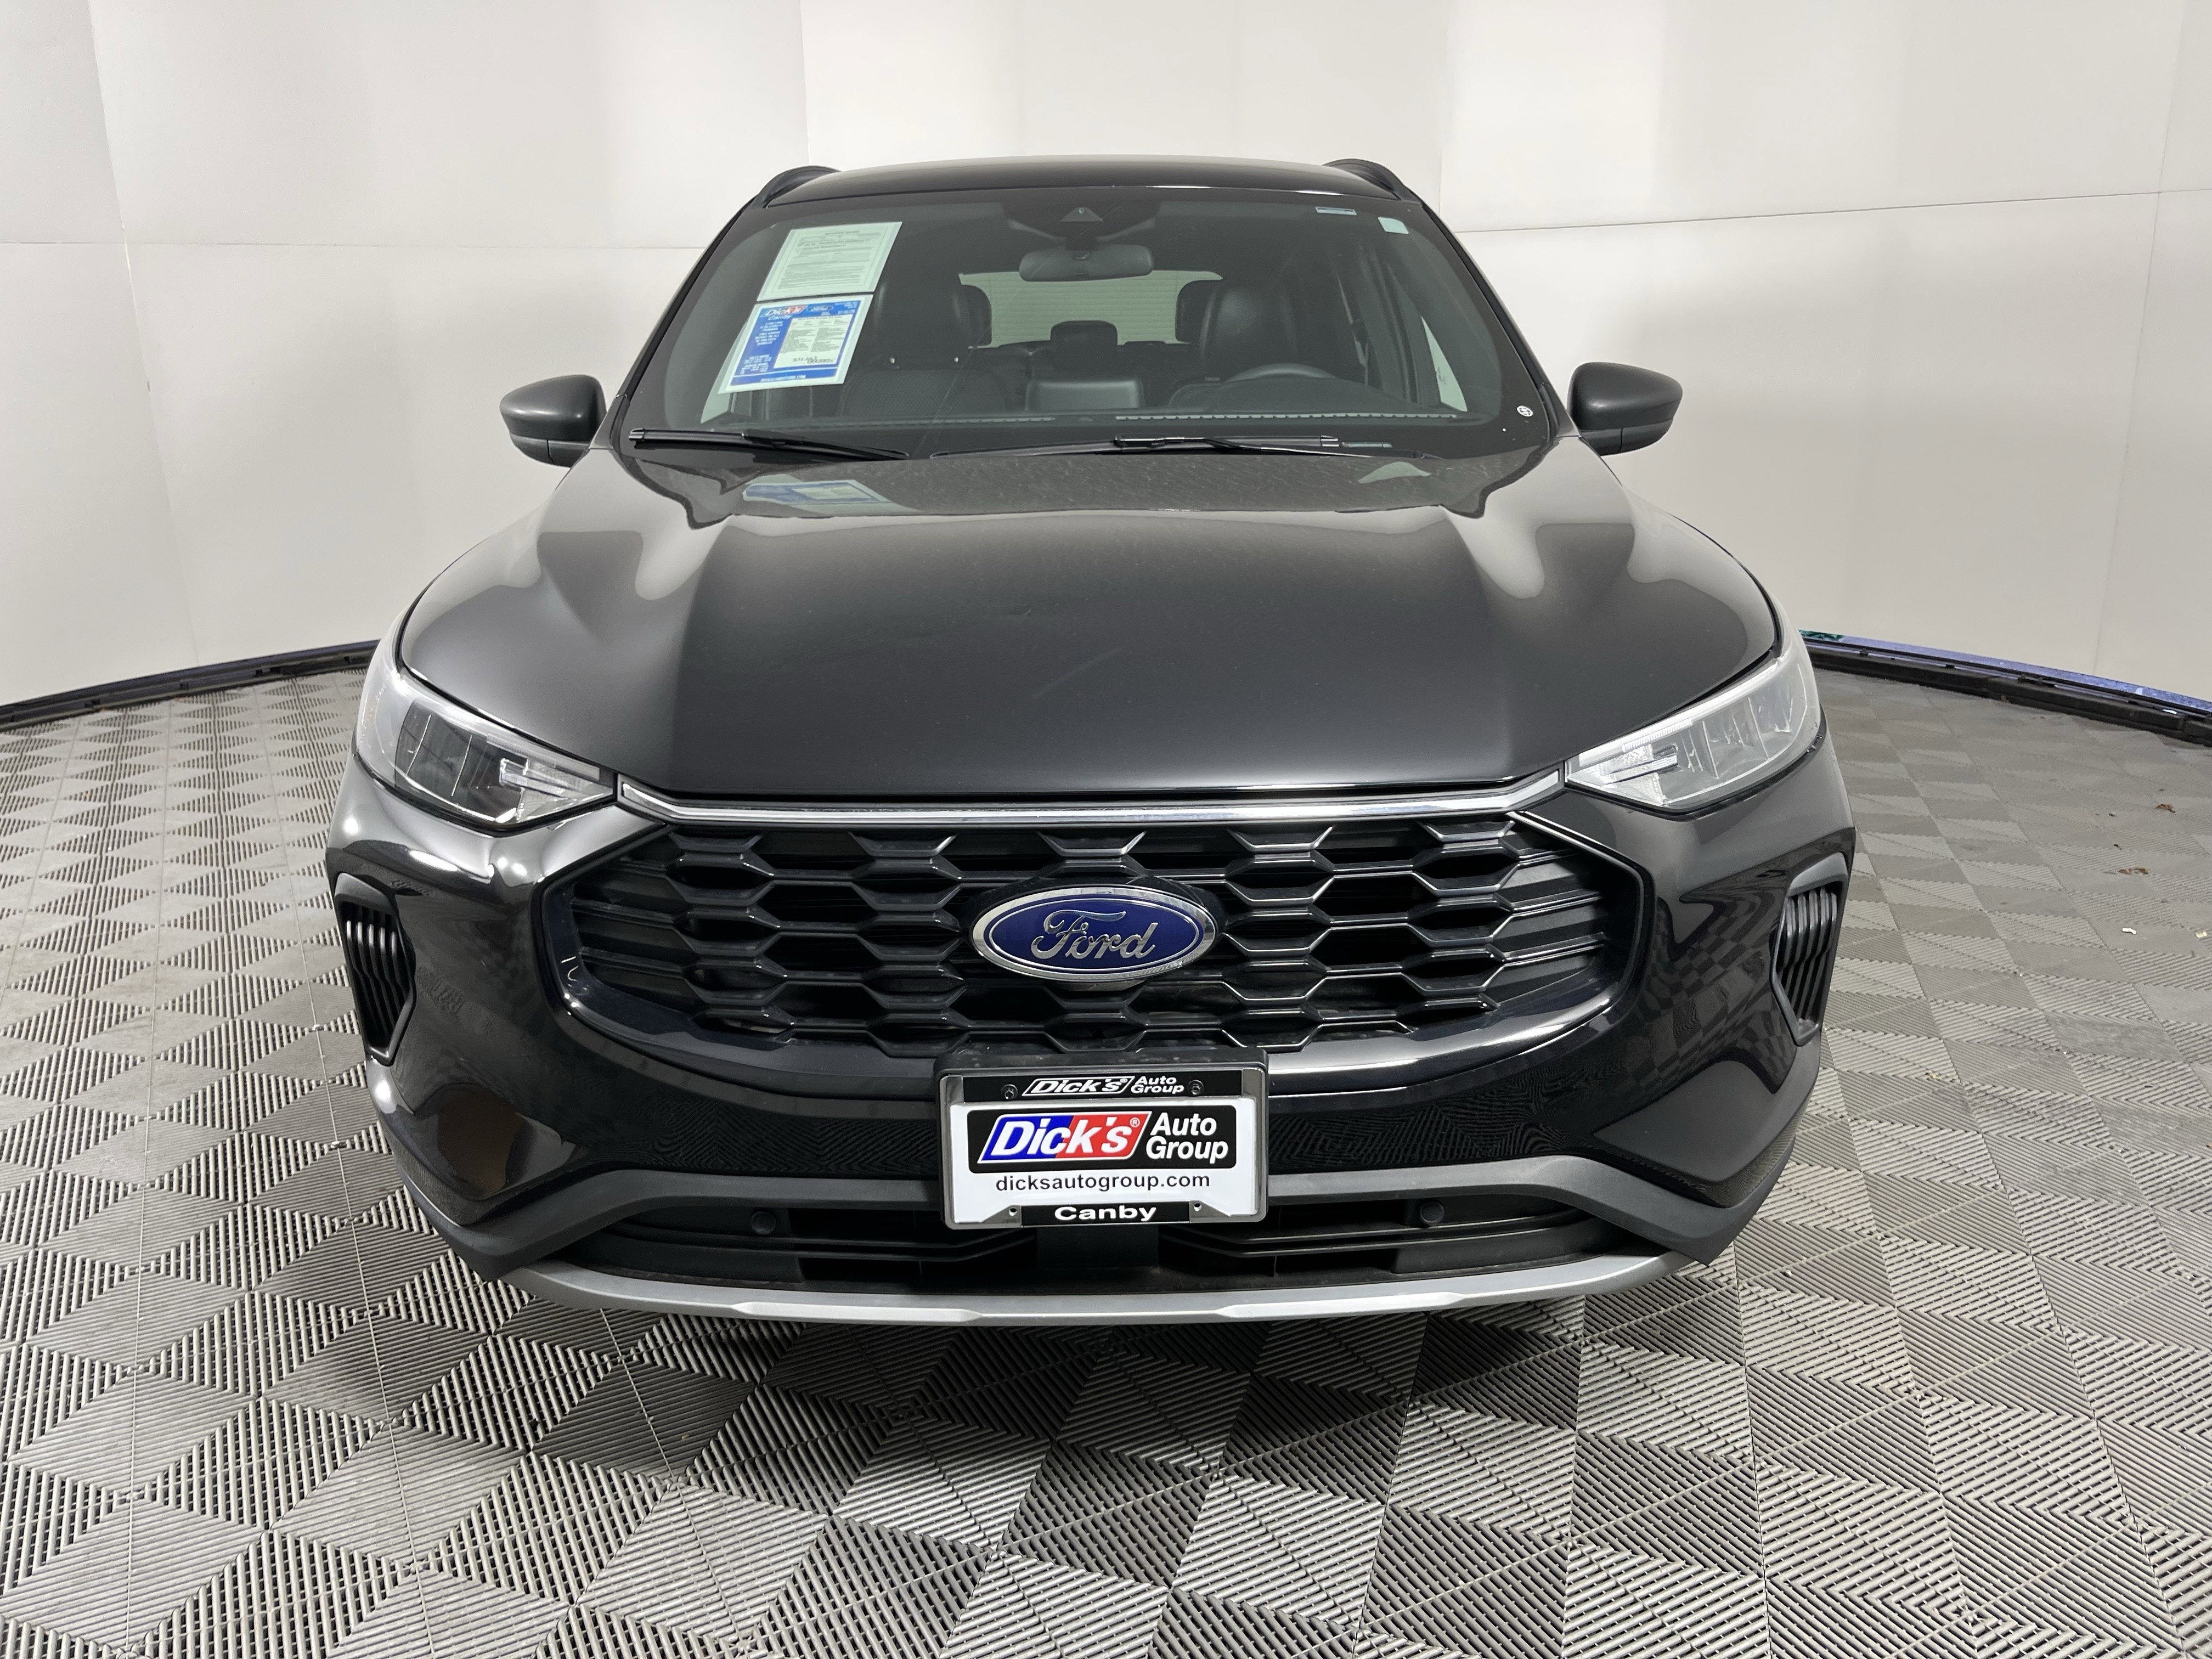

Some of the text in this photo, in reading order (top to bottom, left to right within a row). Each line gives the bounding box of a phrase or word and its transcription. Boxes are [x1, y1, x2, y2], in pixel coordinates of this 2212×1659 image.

[1031, 910, 1158, 959] Ford
[1131, 1084, 1184, 1094] Group
[1138, 1075, 1177, 1085] Auto
[1150, 1112, 1217, 1136] Auto
[1146, 1136, 1228, 1164] Group
[996, 1173, 1210, 1191] dicksautogroup.com
[1054, 1205, 1156, 1221] Canby
